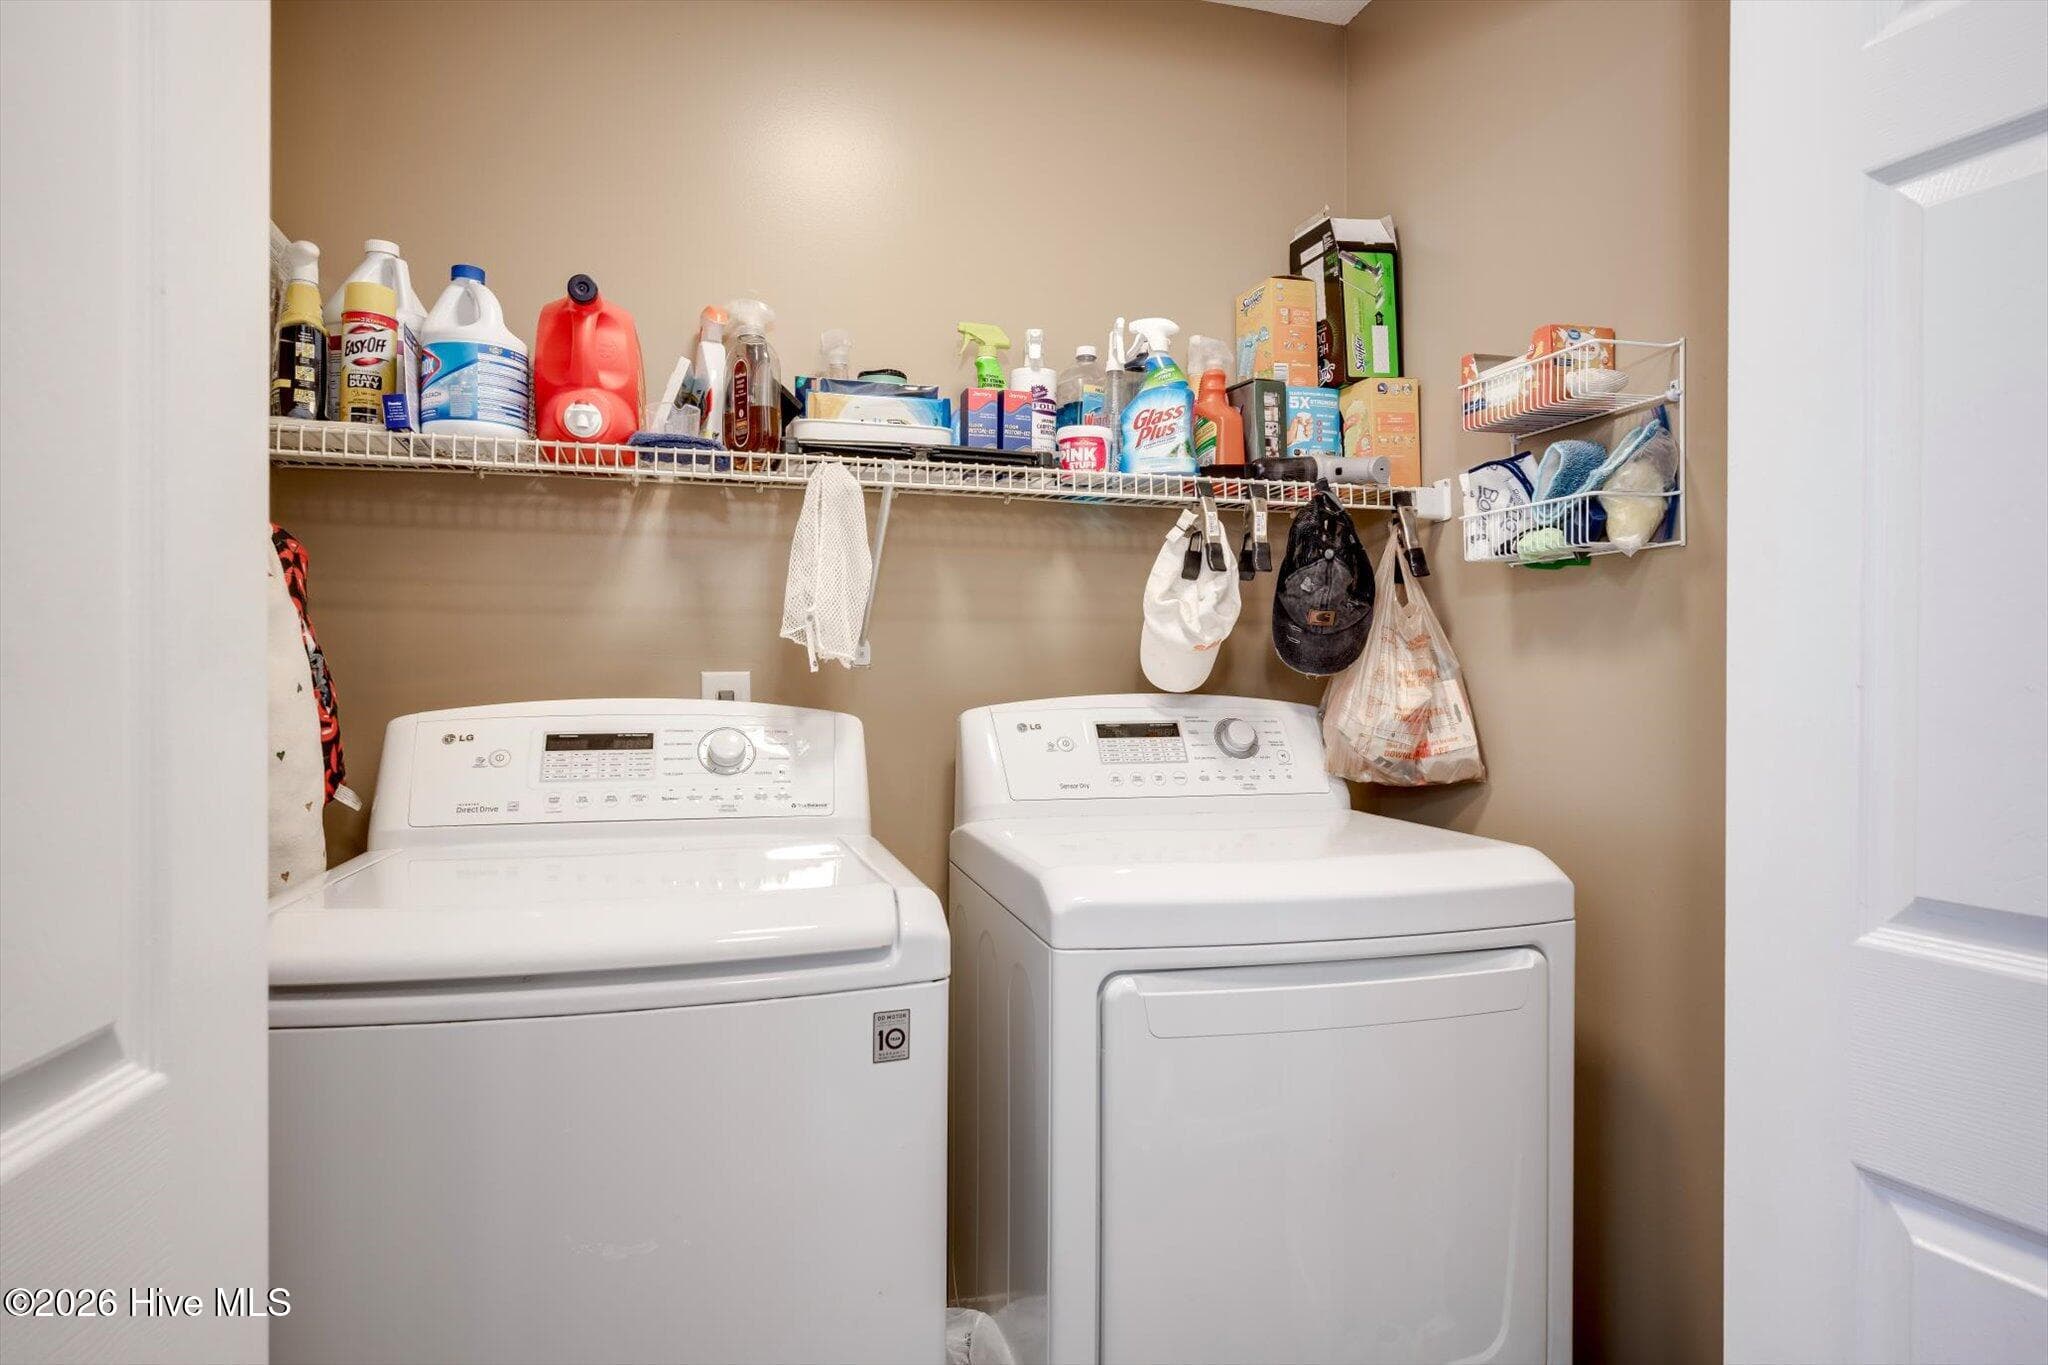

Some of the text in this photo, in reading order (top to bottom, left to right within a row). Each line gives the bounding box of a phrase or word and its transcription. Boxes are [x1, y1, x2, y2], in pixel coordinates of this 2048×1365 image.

[349, 373, 380, 382] HEAVY
[349, 379, 380, 390] DUTY
[1289, 396, 1311, 409] 5X
[1132, 404, 1185, 430] Glass
[1135, 422, 1178, 449] Plus
[458, 734, 474, 742] LG
[456, 805, 499, 814] Direct Drive
[878, 1028, 906, 1050] 10
